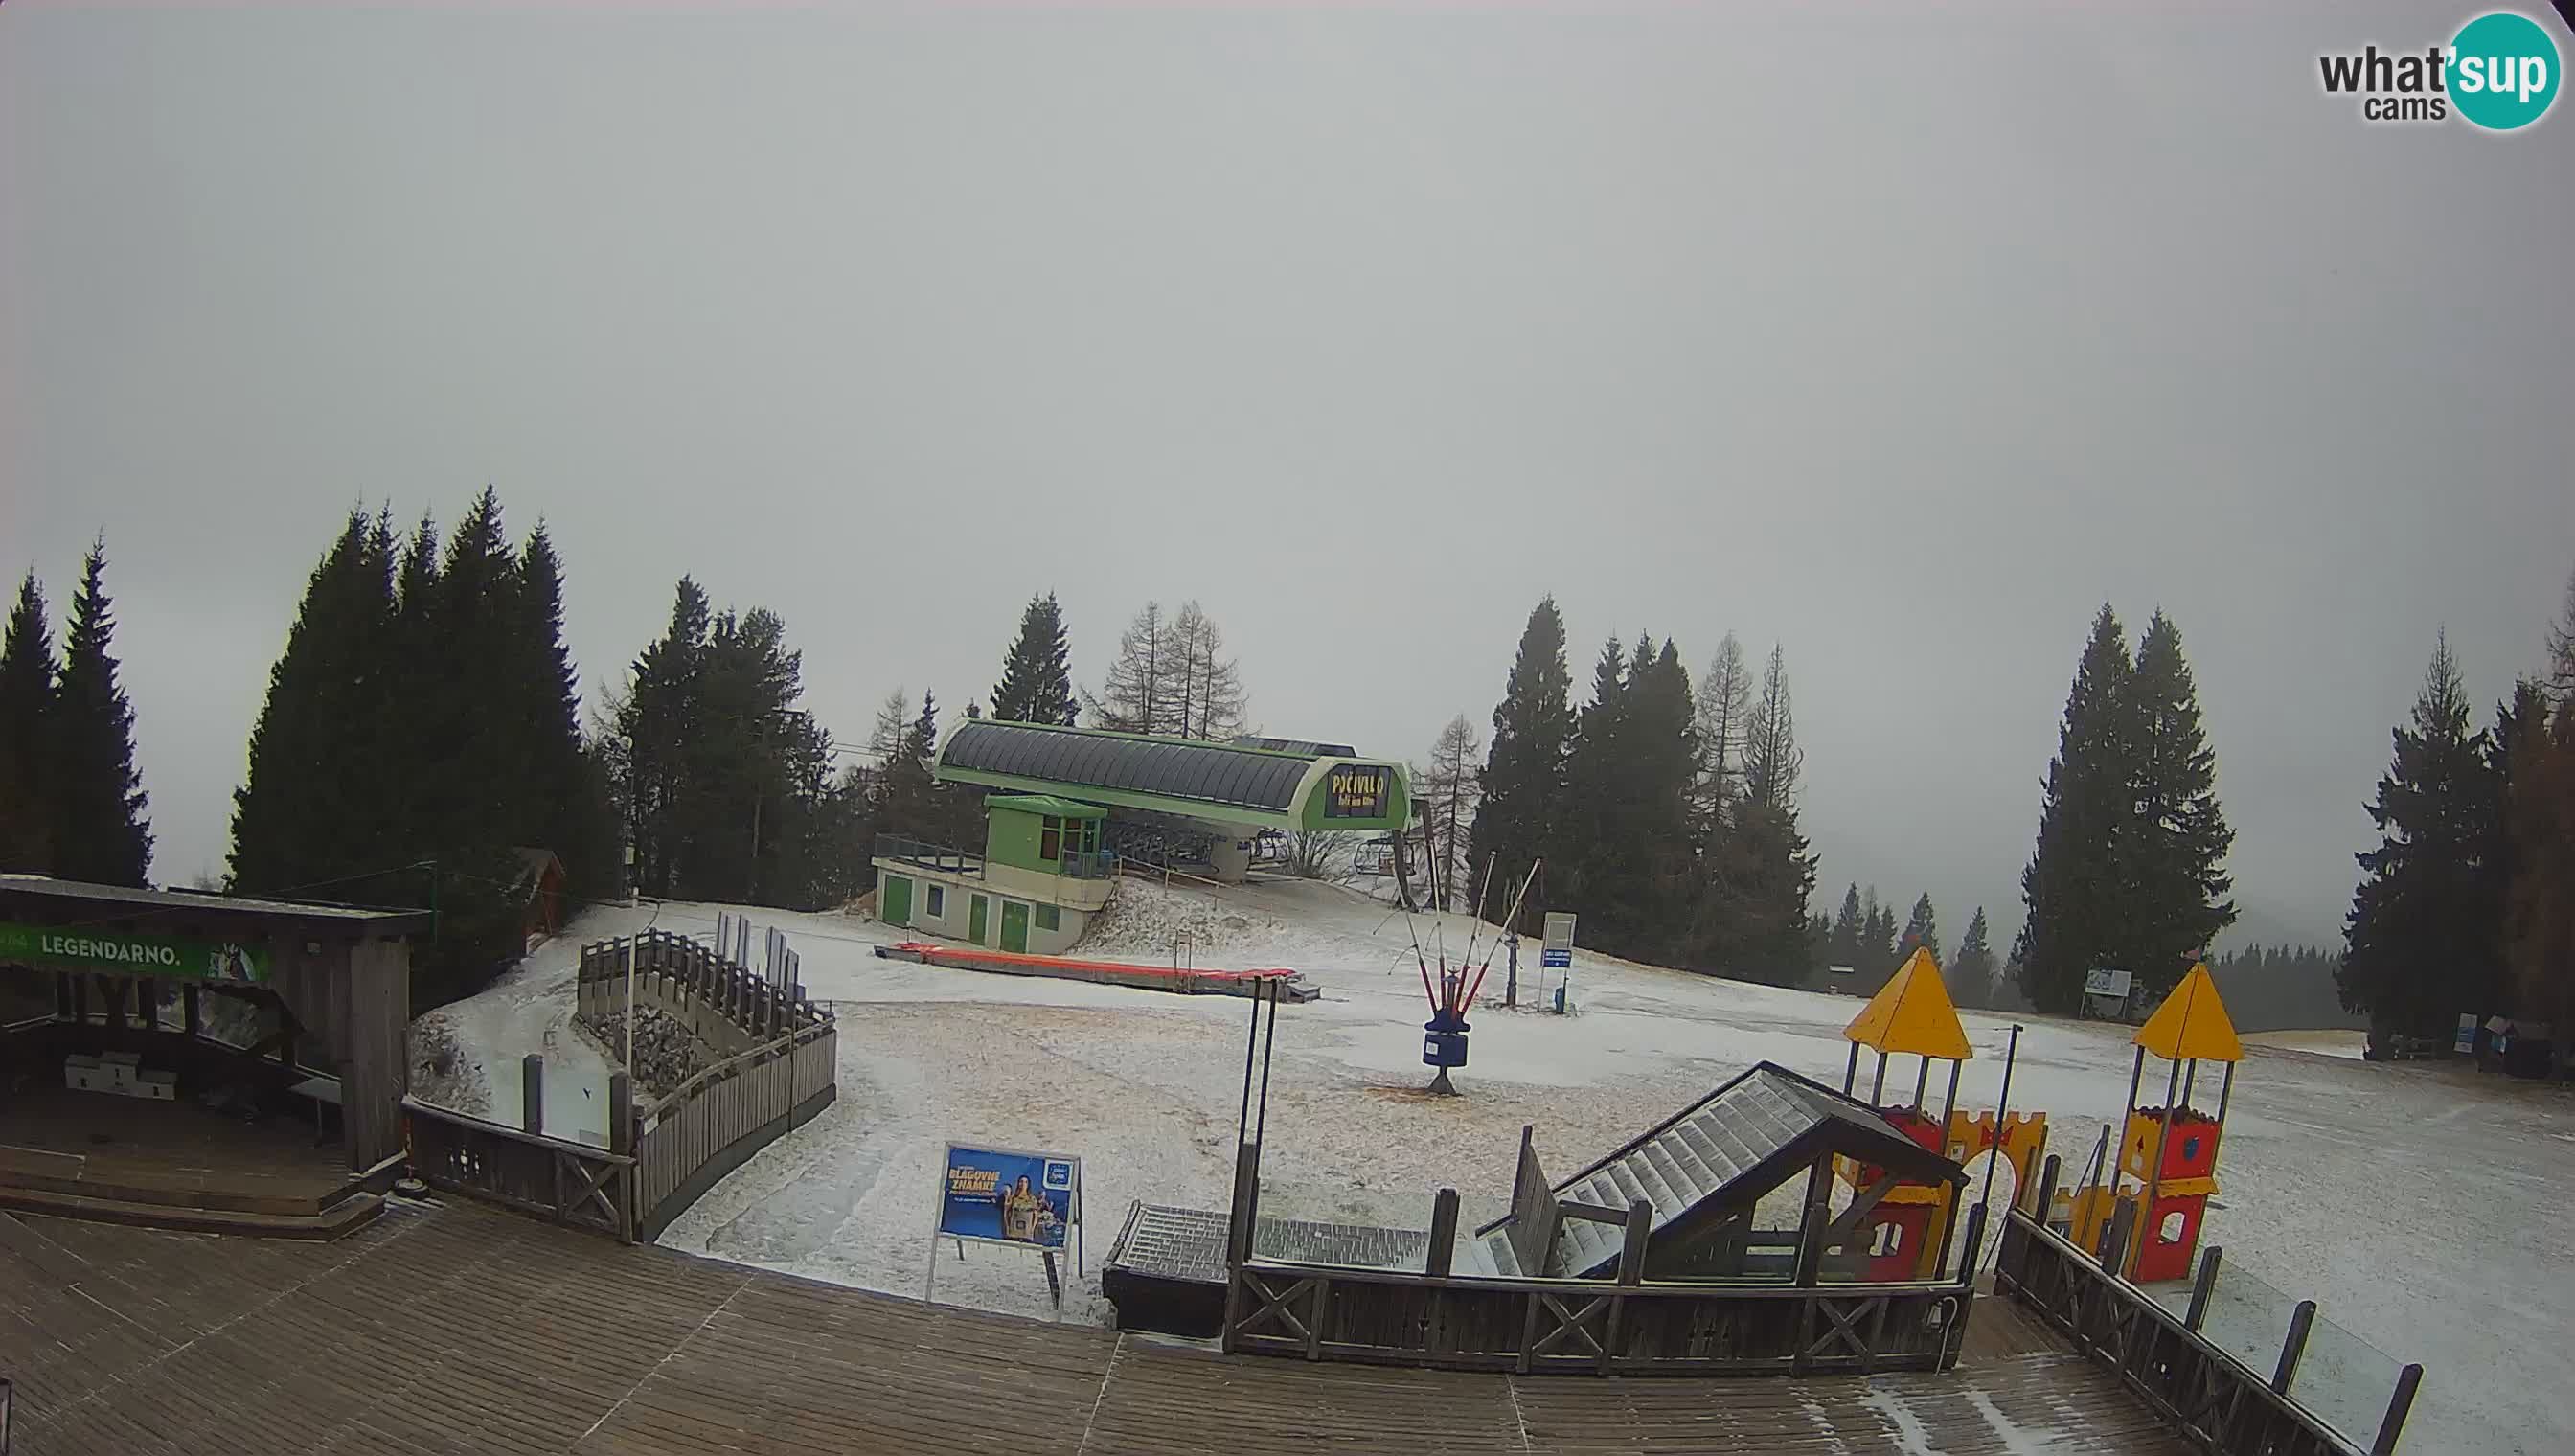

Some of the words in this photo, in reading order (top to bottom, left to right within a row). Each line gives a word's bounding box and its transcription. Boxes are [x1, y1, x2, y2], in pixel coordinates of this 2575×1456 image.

[42, 934, 181, 966] LEGENDARNO.
[949, 1168, 1001, 1181] BLAGOVNE
[951, 1179, 996, 1192] ZNAMKE
